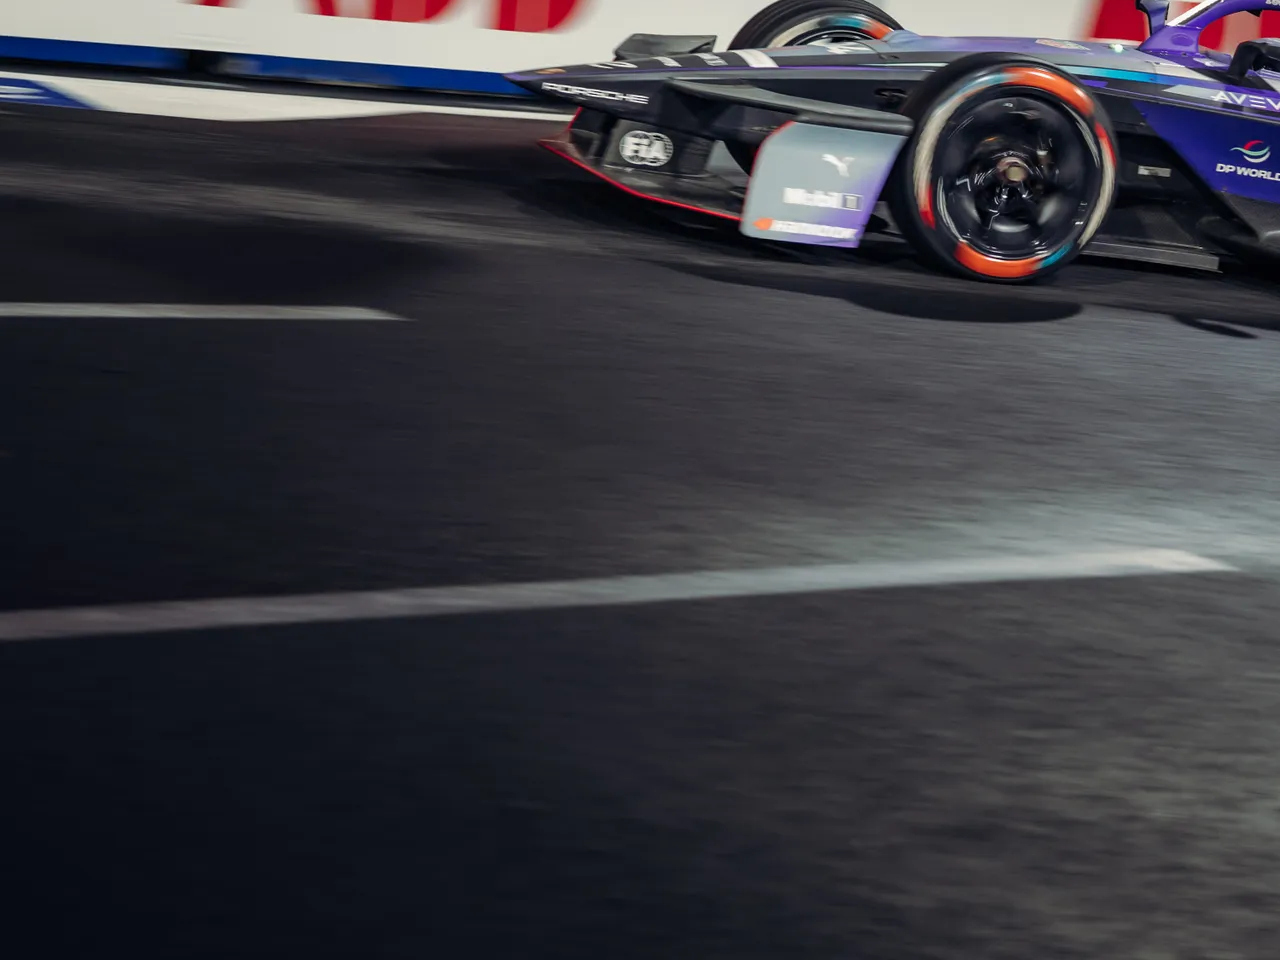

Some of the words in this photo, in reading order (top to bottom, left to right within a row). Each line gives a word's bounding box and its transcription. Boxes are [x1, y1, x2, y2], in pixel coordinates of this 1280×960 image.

[541, 82, 650, 106] PORSCHE
[622, 133, 670, 162] FIA
[1216, 163, 1235, 174] DP
